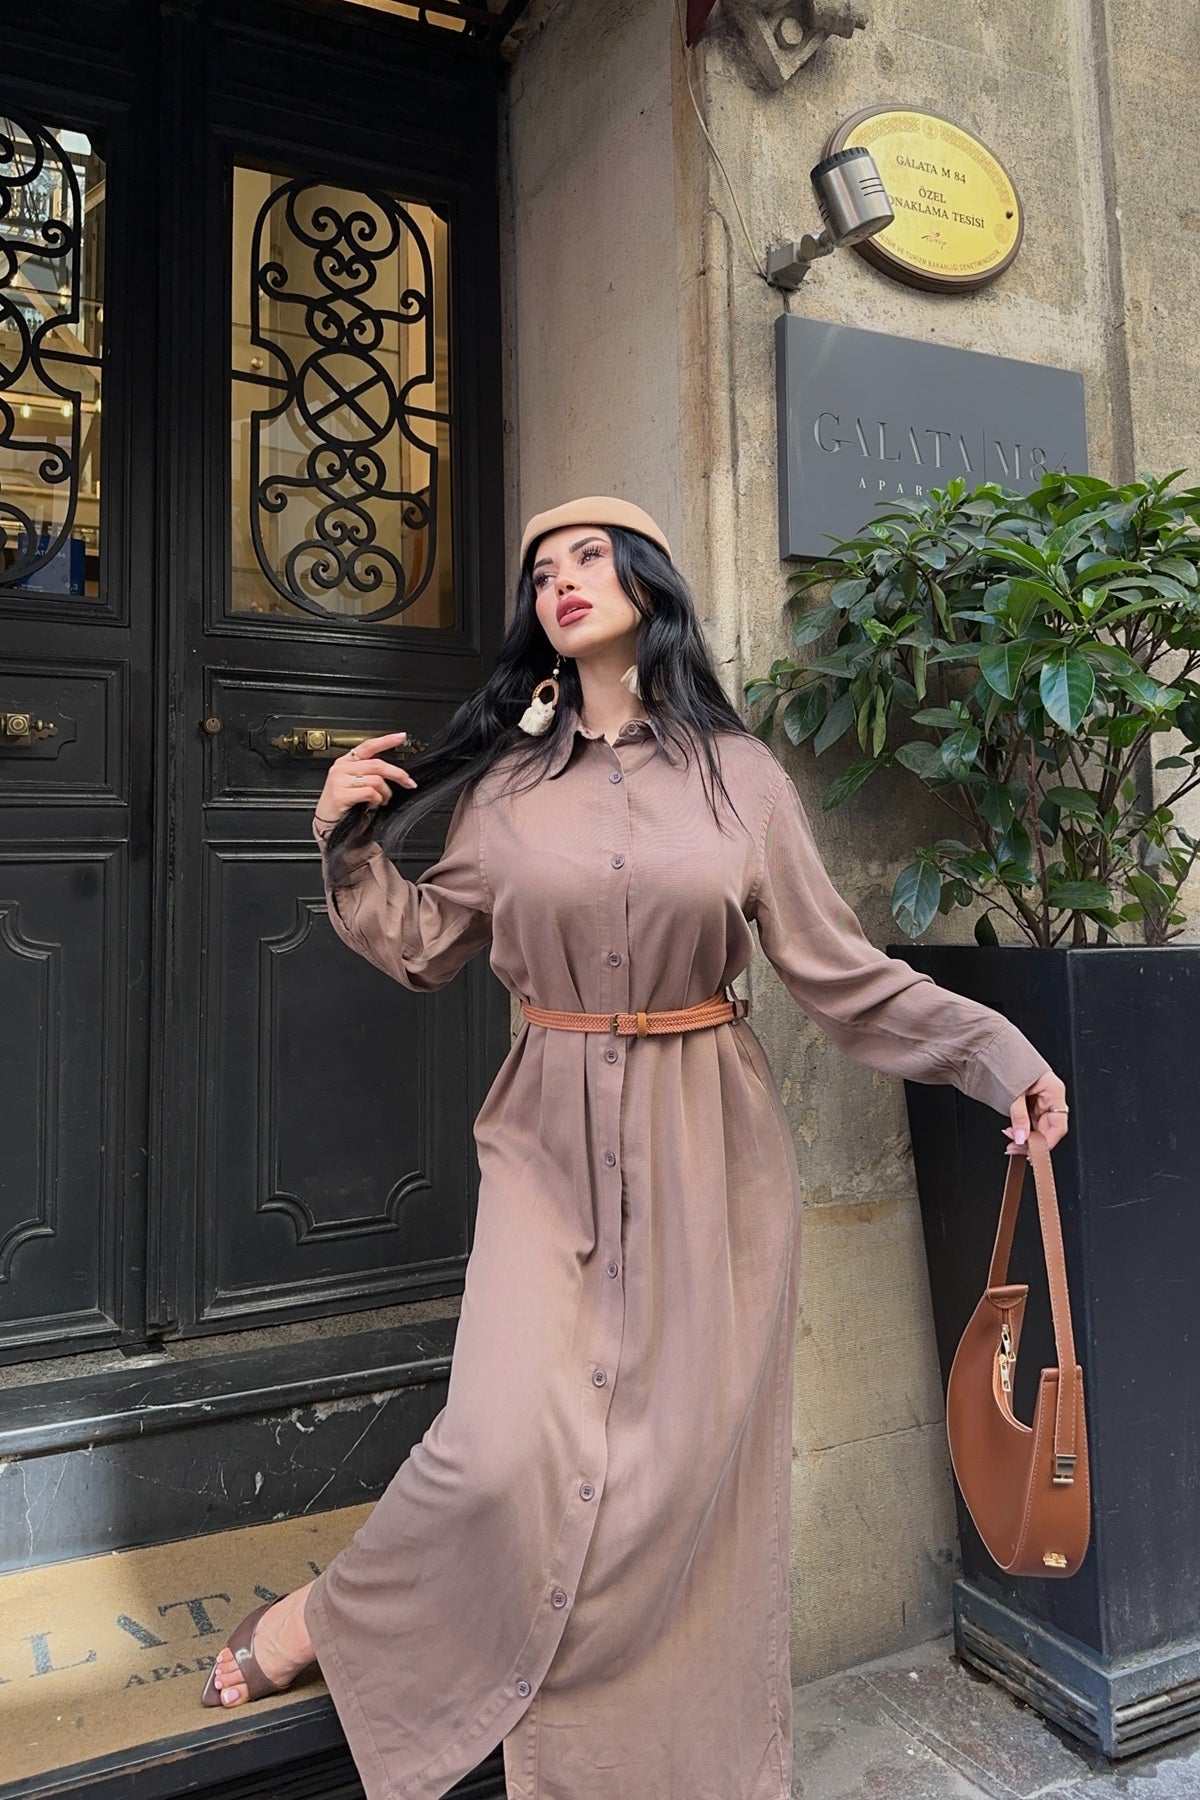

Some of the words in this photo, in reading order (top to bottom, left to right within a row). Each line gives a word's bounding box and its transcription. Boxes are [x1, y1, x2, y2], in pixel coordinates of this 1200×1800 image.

[896, 154, 938, 175] GALATA
[941, 167, 951, 178] M
[954, 171, 967, 184] 84
[918, 185, 947, 204] ÖZEL
[887, 194, 949, 219] ONAKLAMA
[952, 211, 985, 229] TESİSİ
[813, 411, 974, 473] GALATA
[858, 477, 929, 496] APAR
[0, 1584, 278, 1684] LAT
